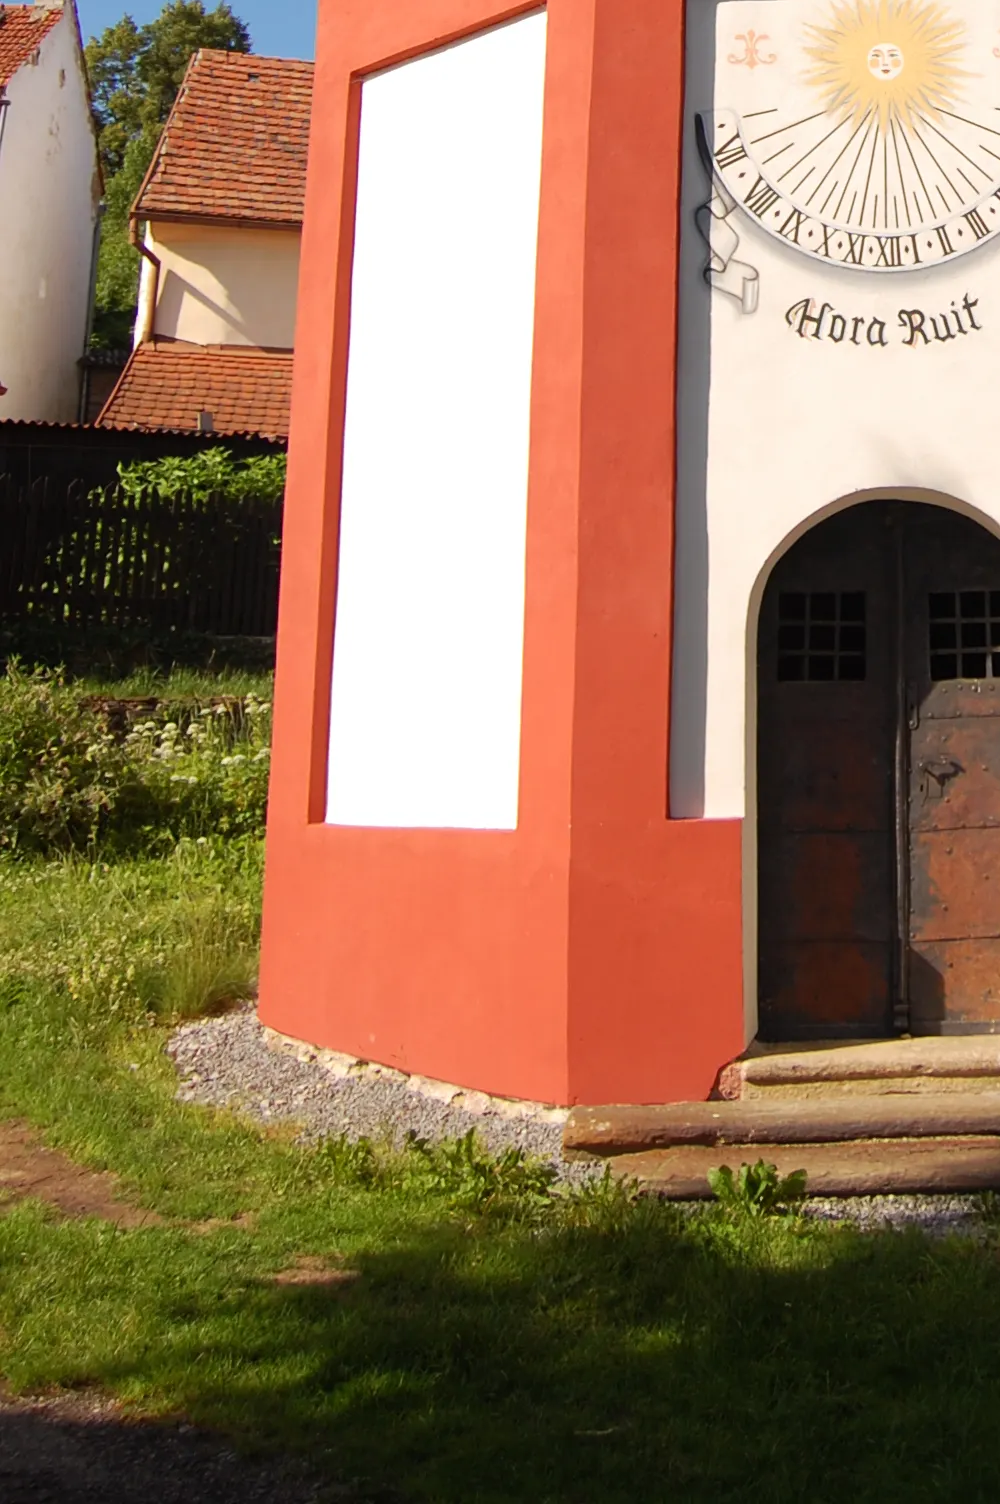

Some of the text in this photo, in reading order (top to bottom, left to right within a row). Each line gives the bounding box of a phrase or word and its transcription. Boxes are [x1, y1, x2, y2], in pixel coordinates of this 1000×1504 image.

[713, 130, 749, 170] VII
[743, 173, 782, 220] VIII
[775, 205, 812, 244] IX
[810, 222, 839, 257] X
[842, 232, 867, 266] XI
[874, 235, 903, 267] XII
[907, 233, 923, 264] I
[932, 224, 957, 256] II
[962, 208, 993, 240] III
[785, 292, 982, 348] Hora Ruit
